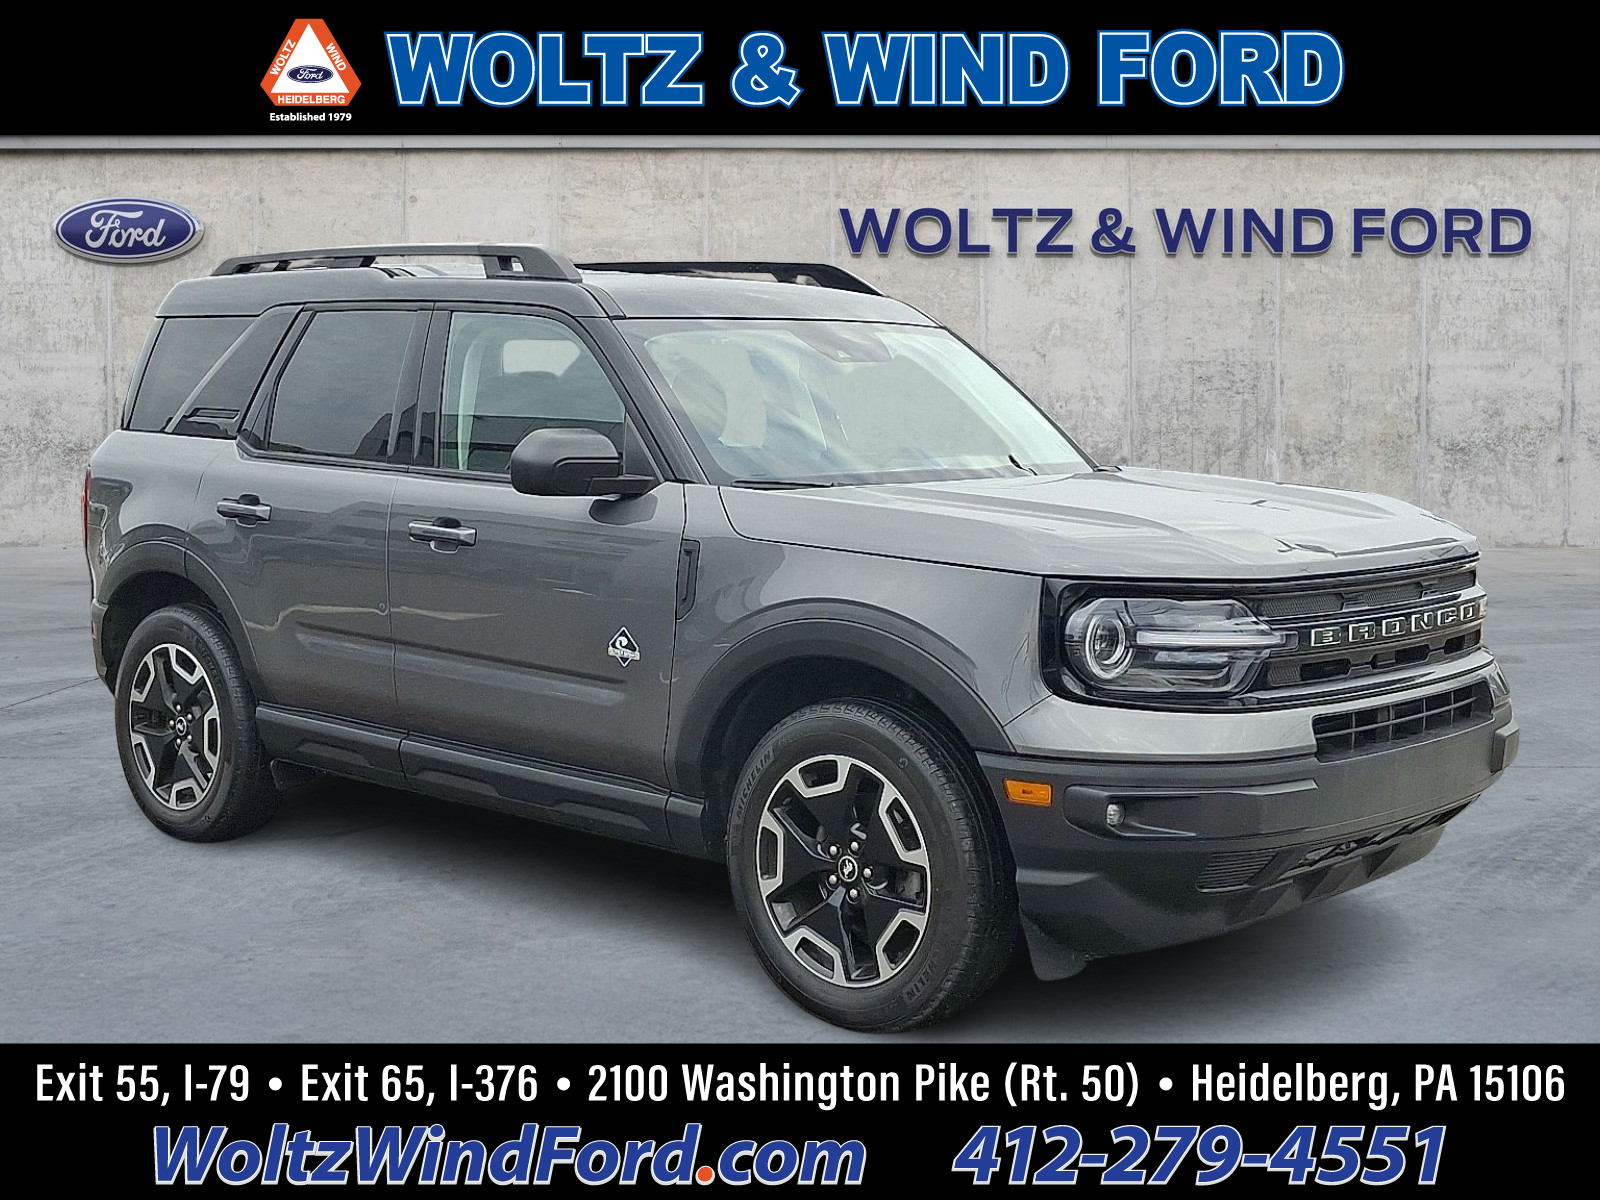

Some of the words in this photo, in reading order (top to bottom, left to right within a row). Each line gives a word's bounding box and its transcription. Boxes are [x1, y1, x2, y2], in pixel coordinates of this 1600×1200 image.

[85, 209, 166, 249] Ford
[840, 208, 1073, 255] WOLTZ
[1091, 208, 1136, 255] &
[1156, 208, 1333, 255] WIND
[1353, 208, 1533, 255] FORD
[1310, 601, 1479, 647] BRONCO
